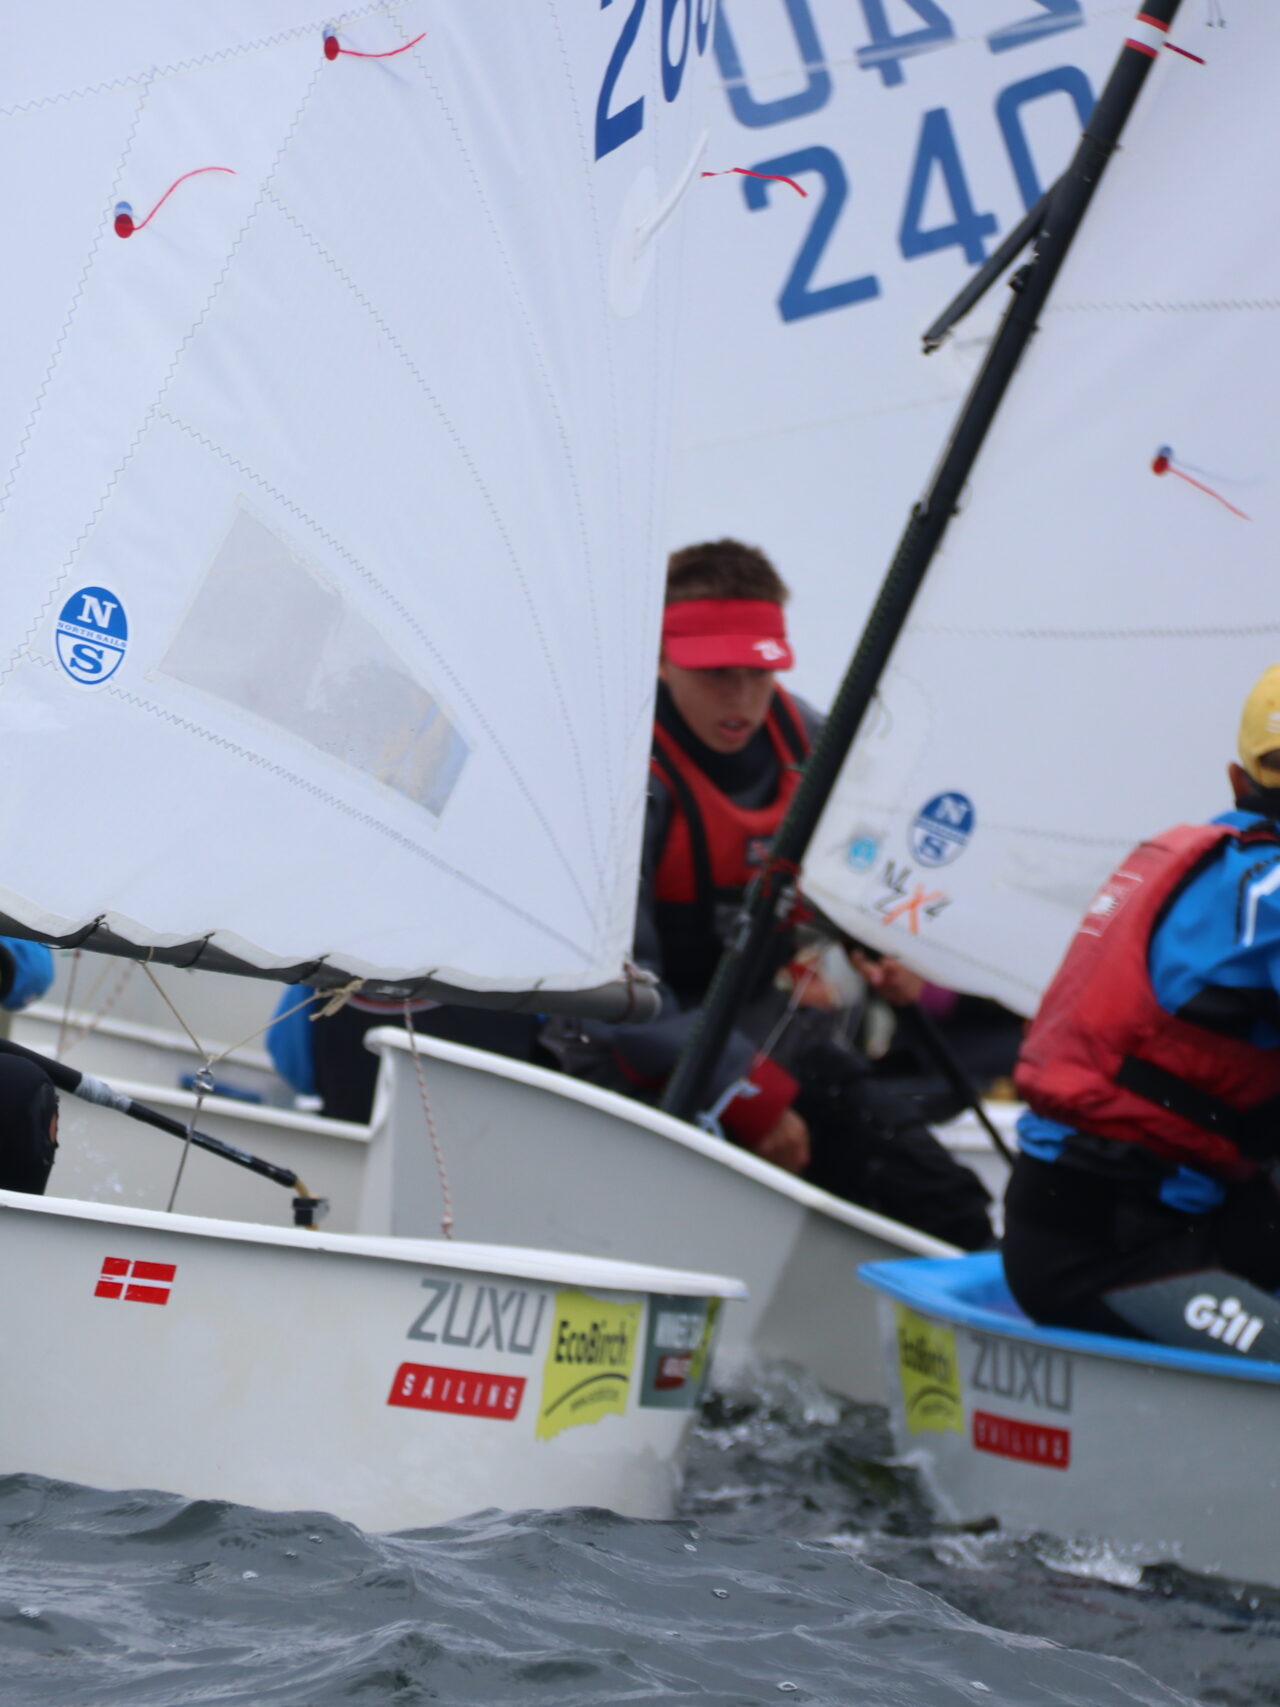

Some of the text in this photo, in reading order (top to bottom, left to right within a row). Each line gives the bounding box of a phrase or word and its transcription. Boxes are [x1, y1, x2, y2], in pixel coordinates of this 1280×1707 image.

[406, 1277, 547, 1355] ZUXU
[1184, 1294, 1264, 1354] Gill
[401, 1373, 517, 1409] SAILING
[973, 1335, 1074, 1414] ZUXU
